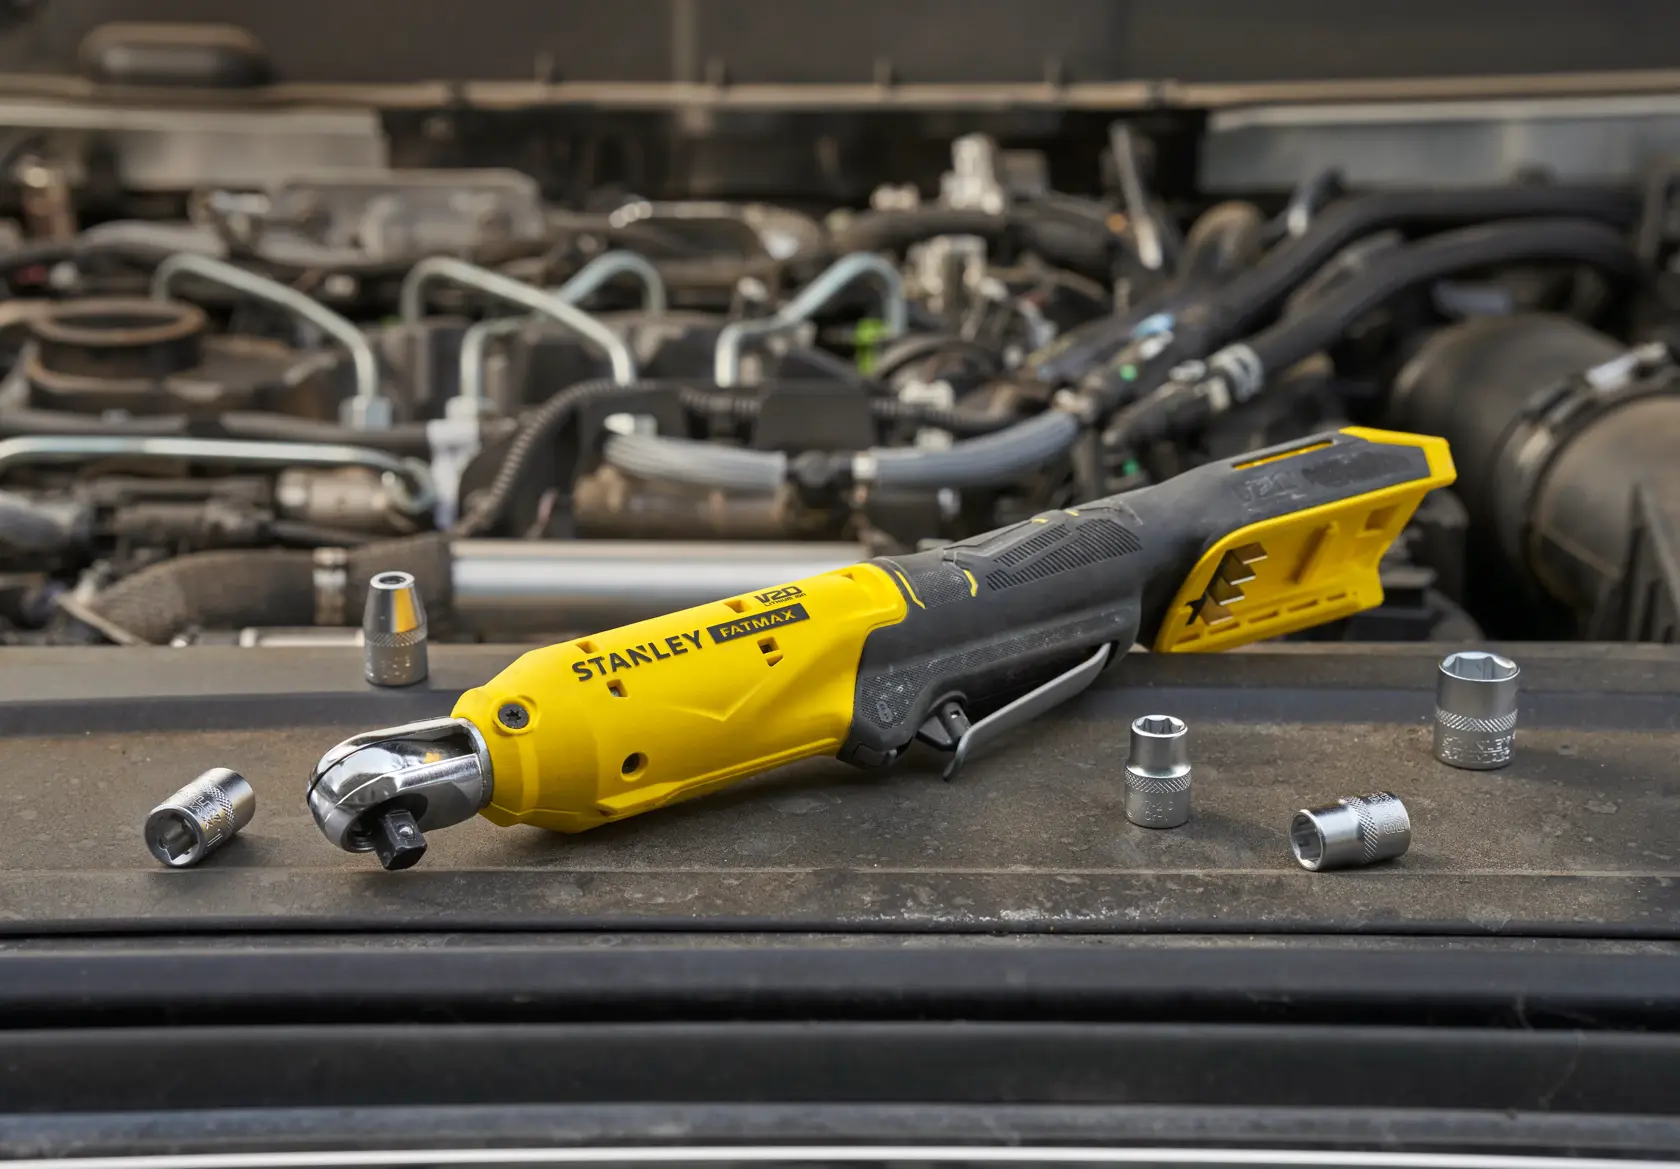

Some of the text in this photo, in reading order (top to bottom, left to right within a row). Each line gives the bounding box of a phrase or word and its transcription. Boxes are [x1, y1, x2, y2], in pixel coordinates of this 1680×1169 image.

[753, 586, 803, 604] V20
[571, 609, 797, 682] STANLEY FATMAX
